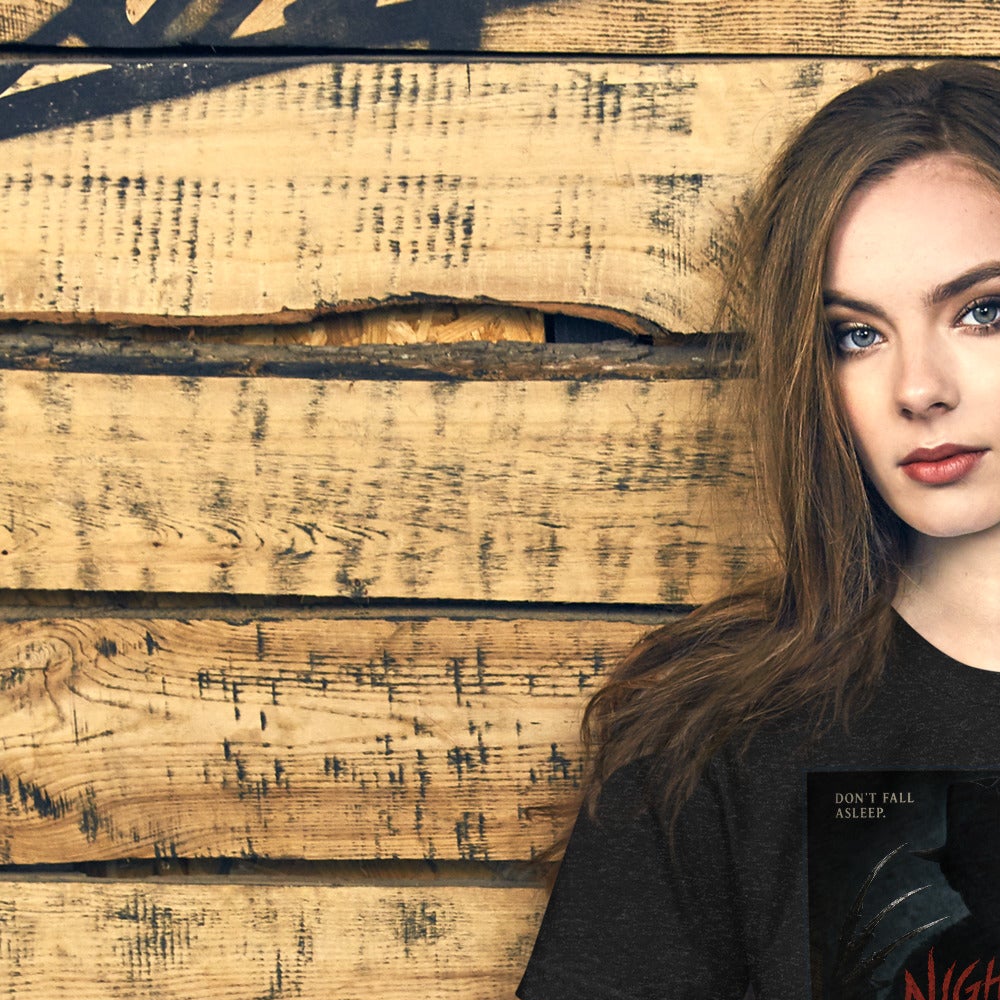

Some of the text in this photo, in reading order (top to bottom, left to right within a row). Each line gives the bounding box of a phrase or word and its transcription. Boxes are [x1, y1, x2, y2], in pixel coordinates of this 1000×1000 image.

[835, 791, 915, 804] DON'T FALL
[835, 807, 887, 819] ASLEEP.
